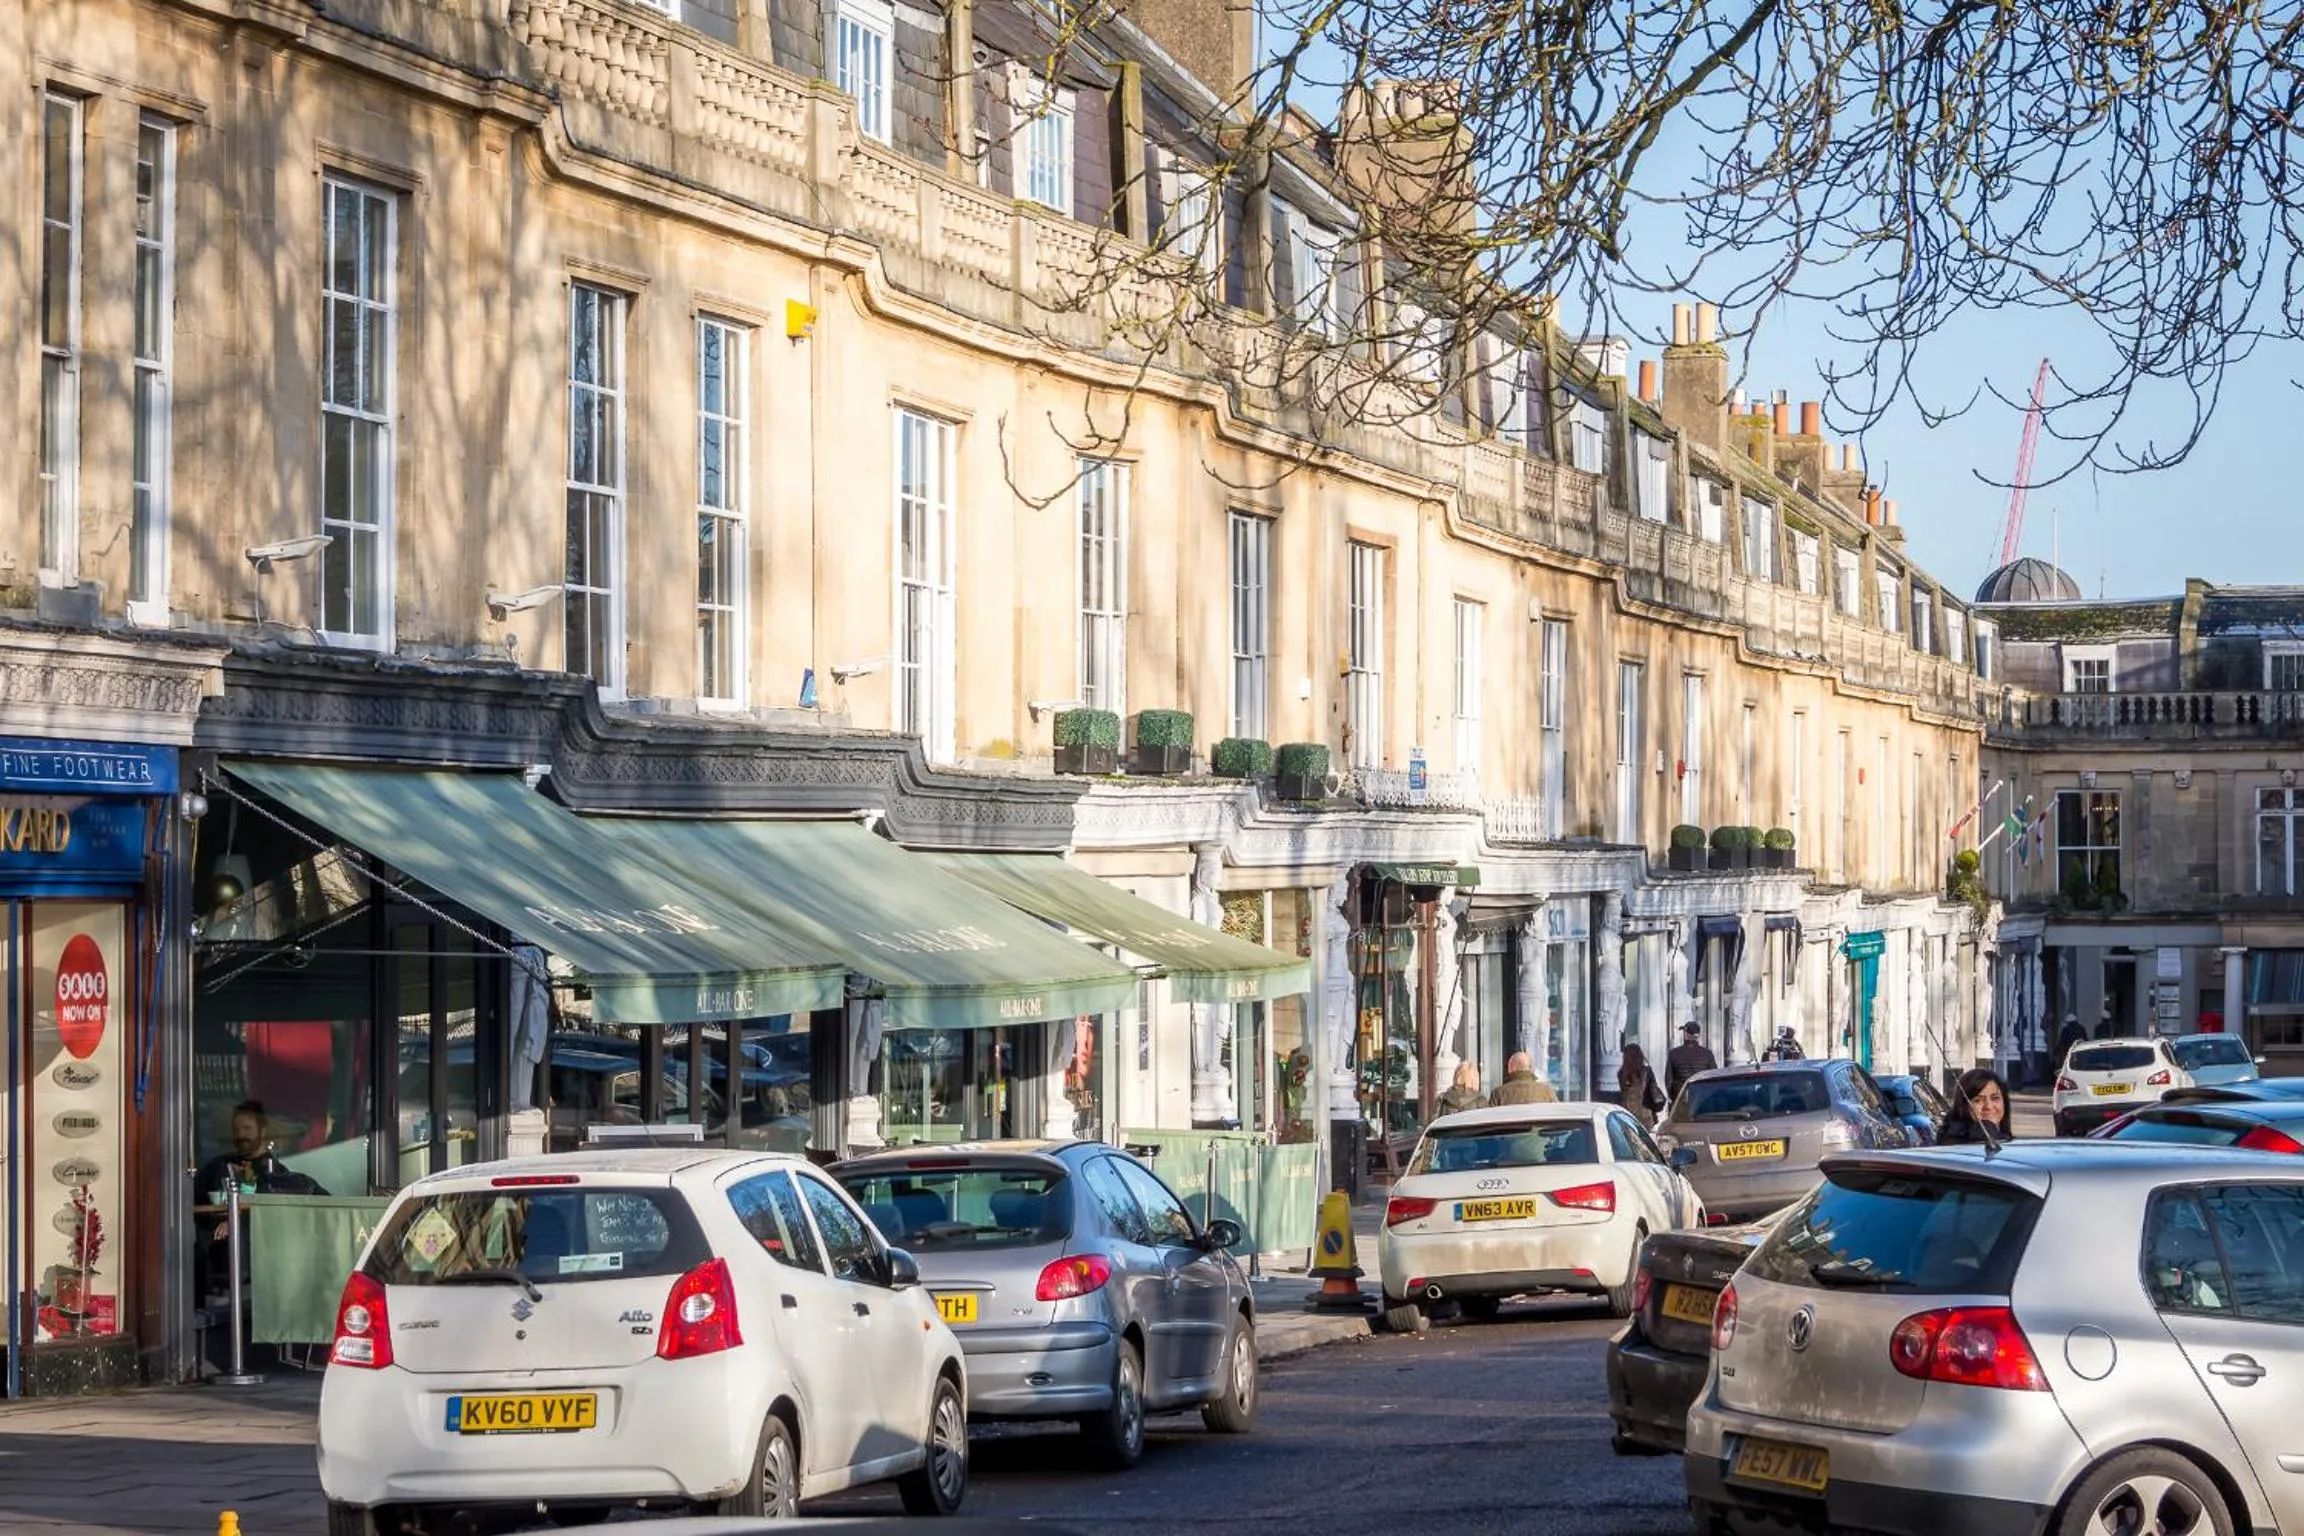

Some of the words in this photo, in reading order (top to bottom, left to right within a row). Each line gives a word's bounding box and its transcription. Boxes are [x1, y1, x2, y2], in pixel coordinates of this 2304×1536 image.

[2, 753, 40, 775] FINE
[53, 756, 152, 780] FOOTWEAR
[58, 972, 106, 1000] SALE
[62, 1005, 86, 1021] NOW
[87, 1003, 101, 1021] ON
[1725, 1145, 1753, 1158] AV57
[1465, 1202, 1501, 1217] VN63
[1507, 1200, 1535, 1214] AVR
[618, 1310, 653, 1323] Alto
[936, 1297, 968, 1318] TH
[465, 1401, 533, 1425] KV60
[542, 1398, 591, 1423] VYF
